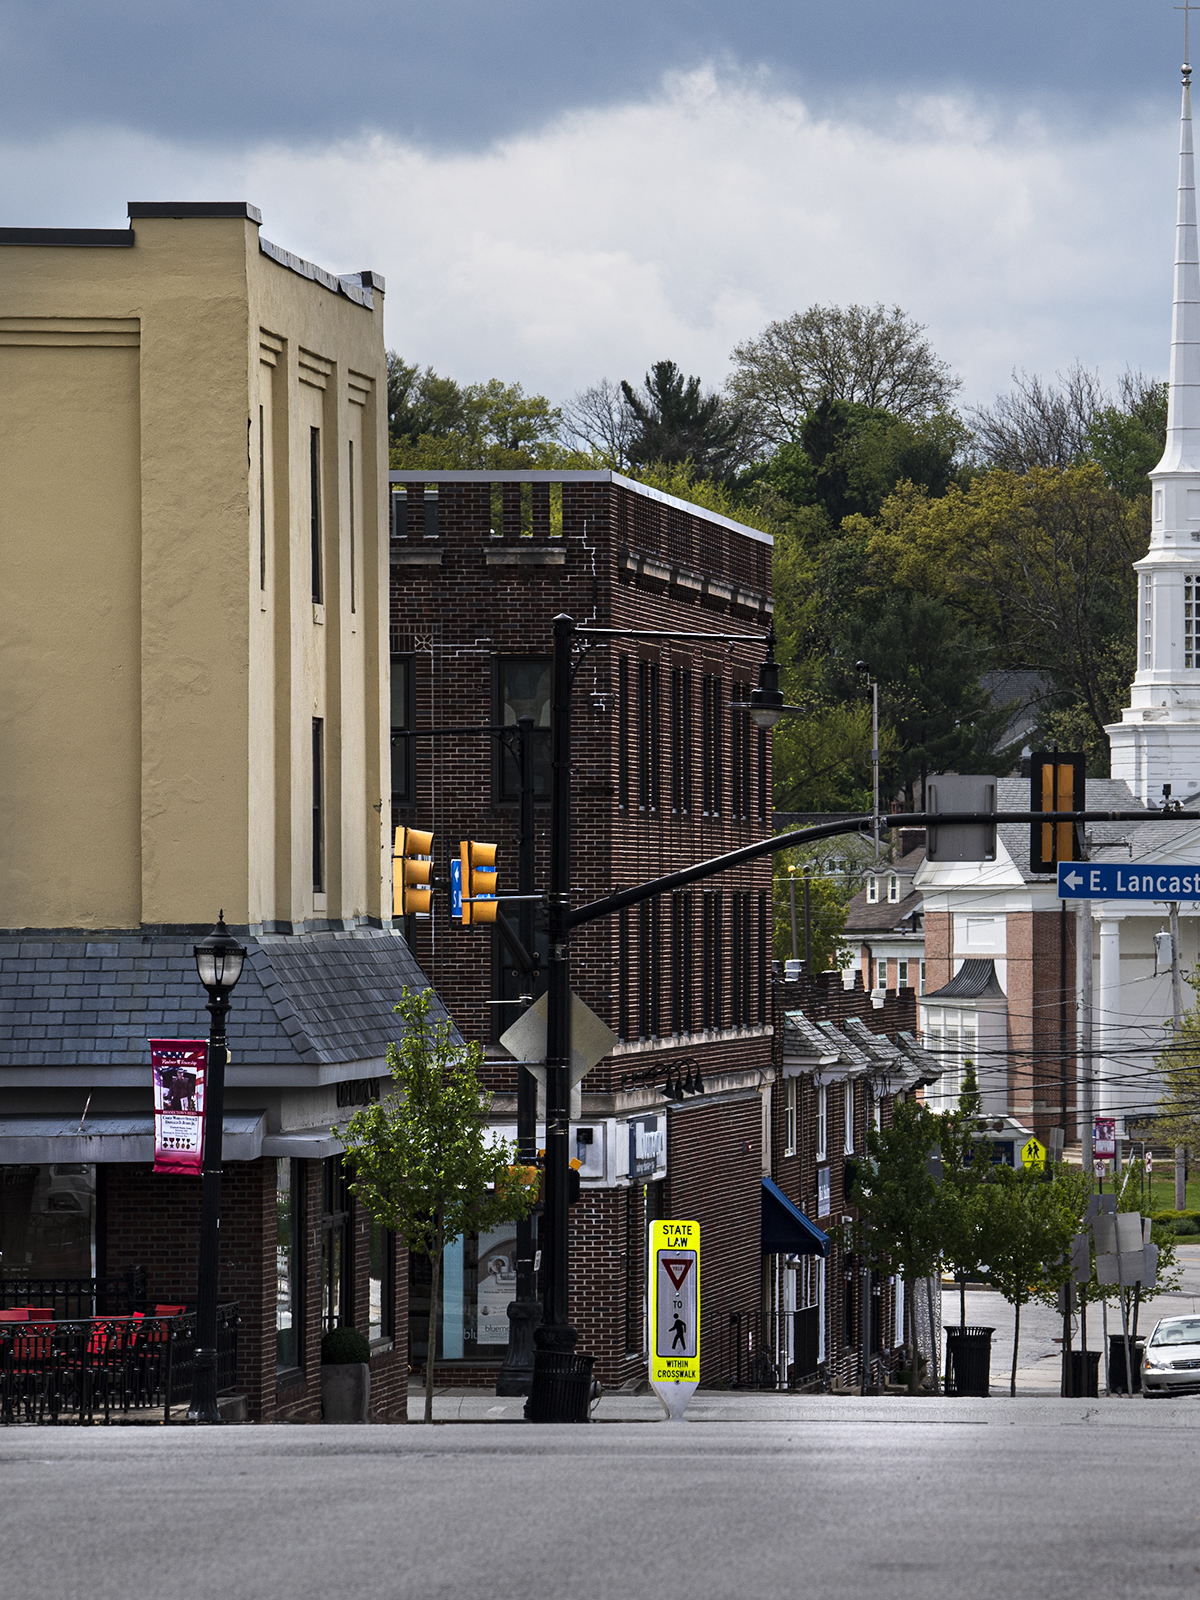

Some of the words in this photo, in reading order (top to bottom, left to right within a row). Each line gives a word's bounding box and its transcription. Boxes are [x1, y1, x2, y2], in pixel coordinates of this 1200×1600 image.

[1089, 870, 1107, 892] E.
[662, 1225, 693, 1235] STATE
[667, 1237, 688, 1247] LAW
[673, 1300, 683, 1309] TO
[666, 1360, 689, 1368] WITHIN
[657, 1369, 696, 1378] CROSSWALK
